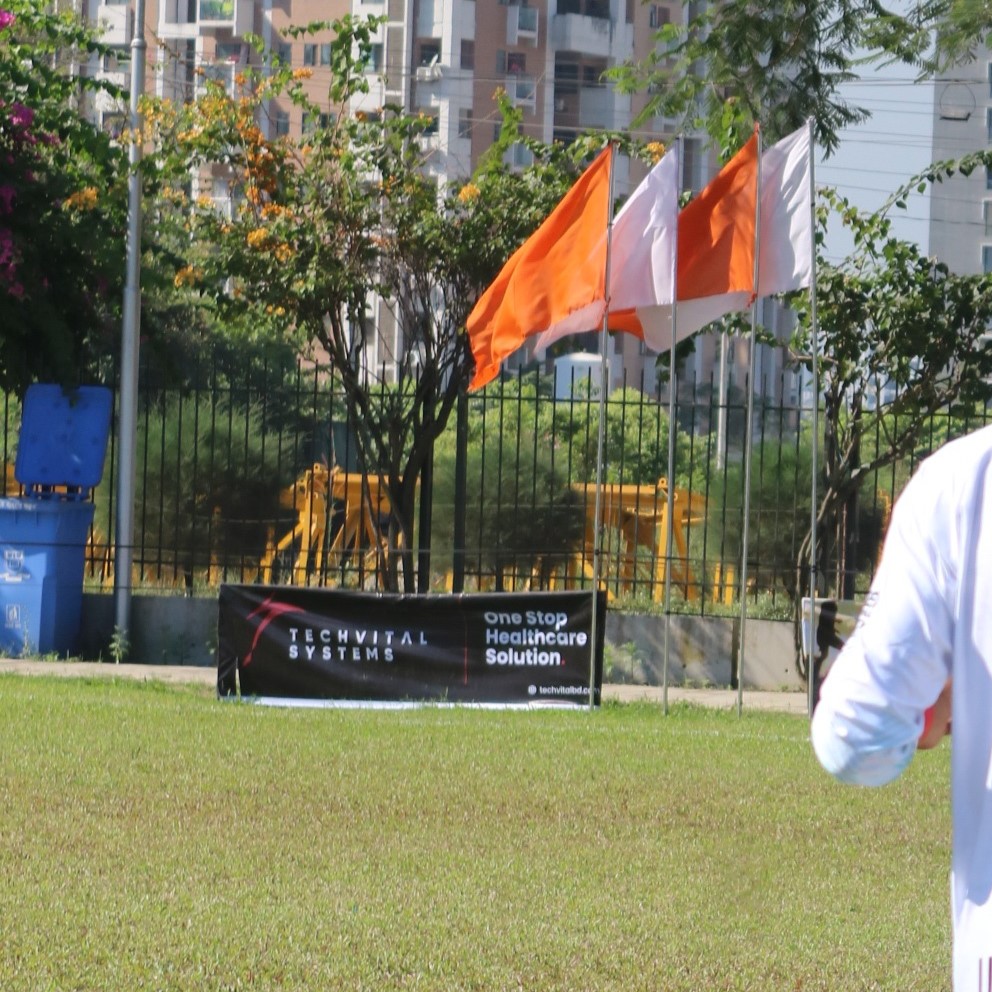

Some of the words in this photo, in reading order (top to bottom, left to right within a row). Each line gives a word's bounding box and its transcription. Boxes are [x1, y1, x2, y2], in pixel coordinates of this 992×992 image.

[525, 610, 568, 631] Stop
[289, 628, 428, 645] TECHVITAL
[485, 628, 588, 646] Healthcare
[289, 644, 394, 661] SYSTEMS
